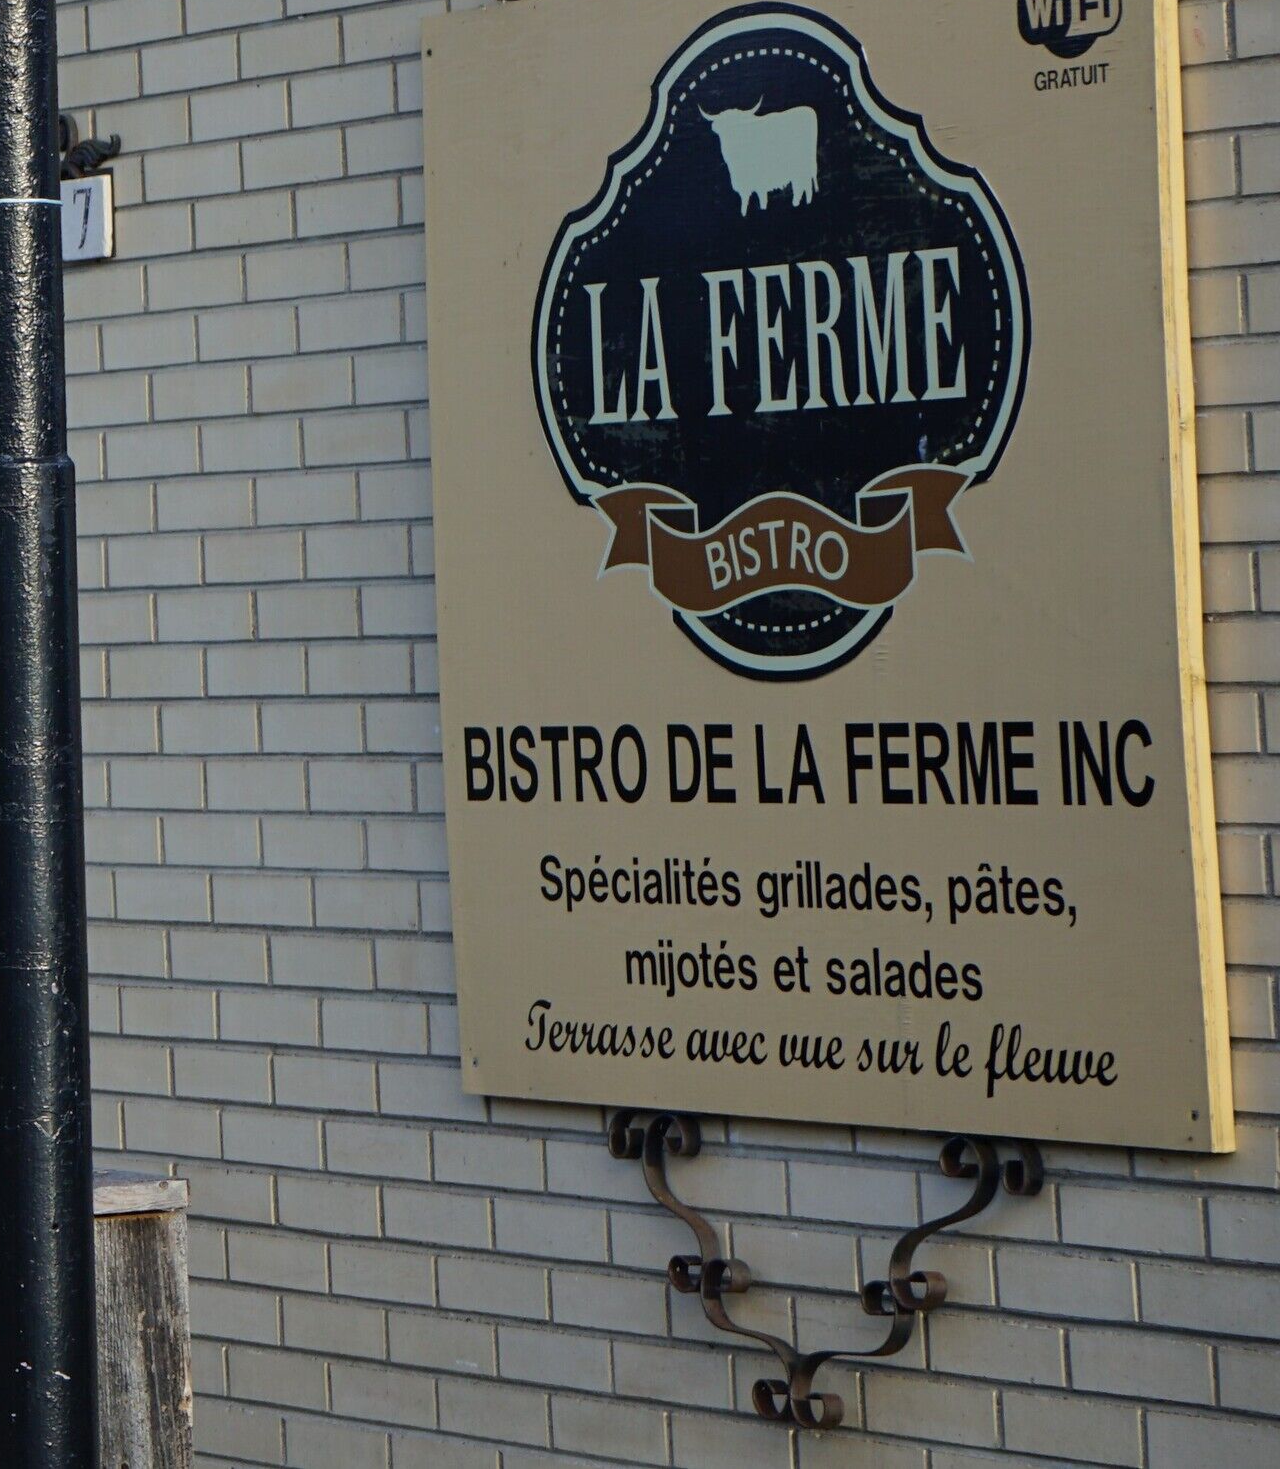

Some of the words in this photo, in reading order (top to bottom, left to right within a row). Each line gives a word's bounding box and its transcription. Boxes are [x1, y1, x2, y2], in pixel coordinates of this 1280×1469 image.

[1034, 63, 1110, 91] GRATUIT
[583, 276, 680, 425] LA
[701, 246, 968, 417] FERME
[705, 520, 849, 591] BISTRO
[464, 724, 648, 803] BISTRO
[667, 723, 737, 804] DE
[754, 723, 826, 805] LA
[845, 720, 1039, 806] FERME
[1059, 719, 1156, 808] INC
[540, 853, 741, 912] Spécialités
[756, 858, 934, 923] grillades,
[948, 862, 1079, 927] pâtes,
[625, 939, 757, 999] mijotés
[773, 945, 811, 994] et
[826, 947, 984, 1002] salades
[525, 998, 675, 1060] Terrasse
[686, 1023, 768, 1066] avec
[778, 1032, 844, 1071] vue
[856, 1035, 923, 1077] sur
[935, 1021, 973, 1079] le
[984, 1023, 1119, 1098] fleuve
